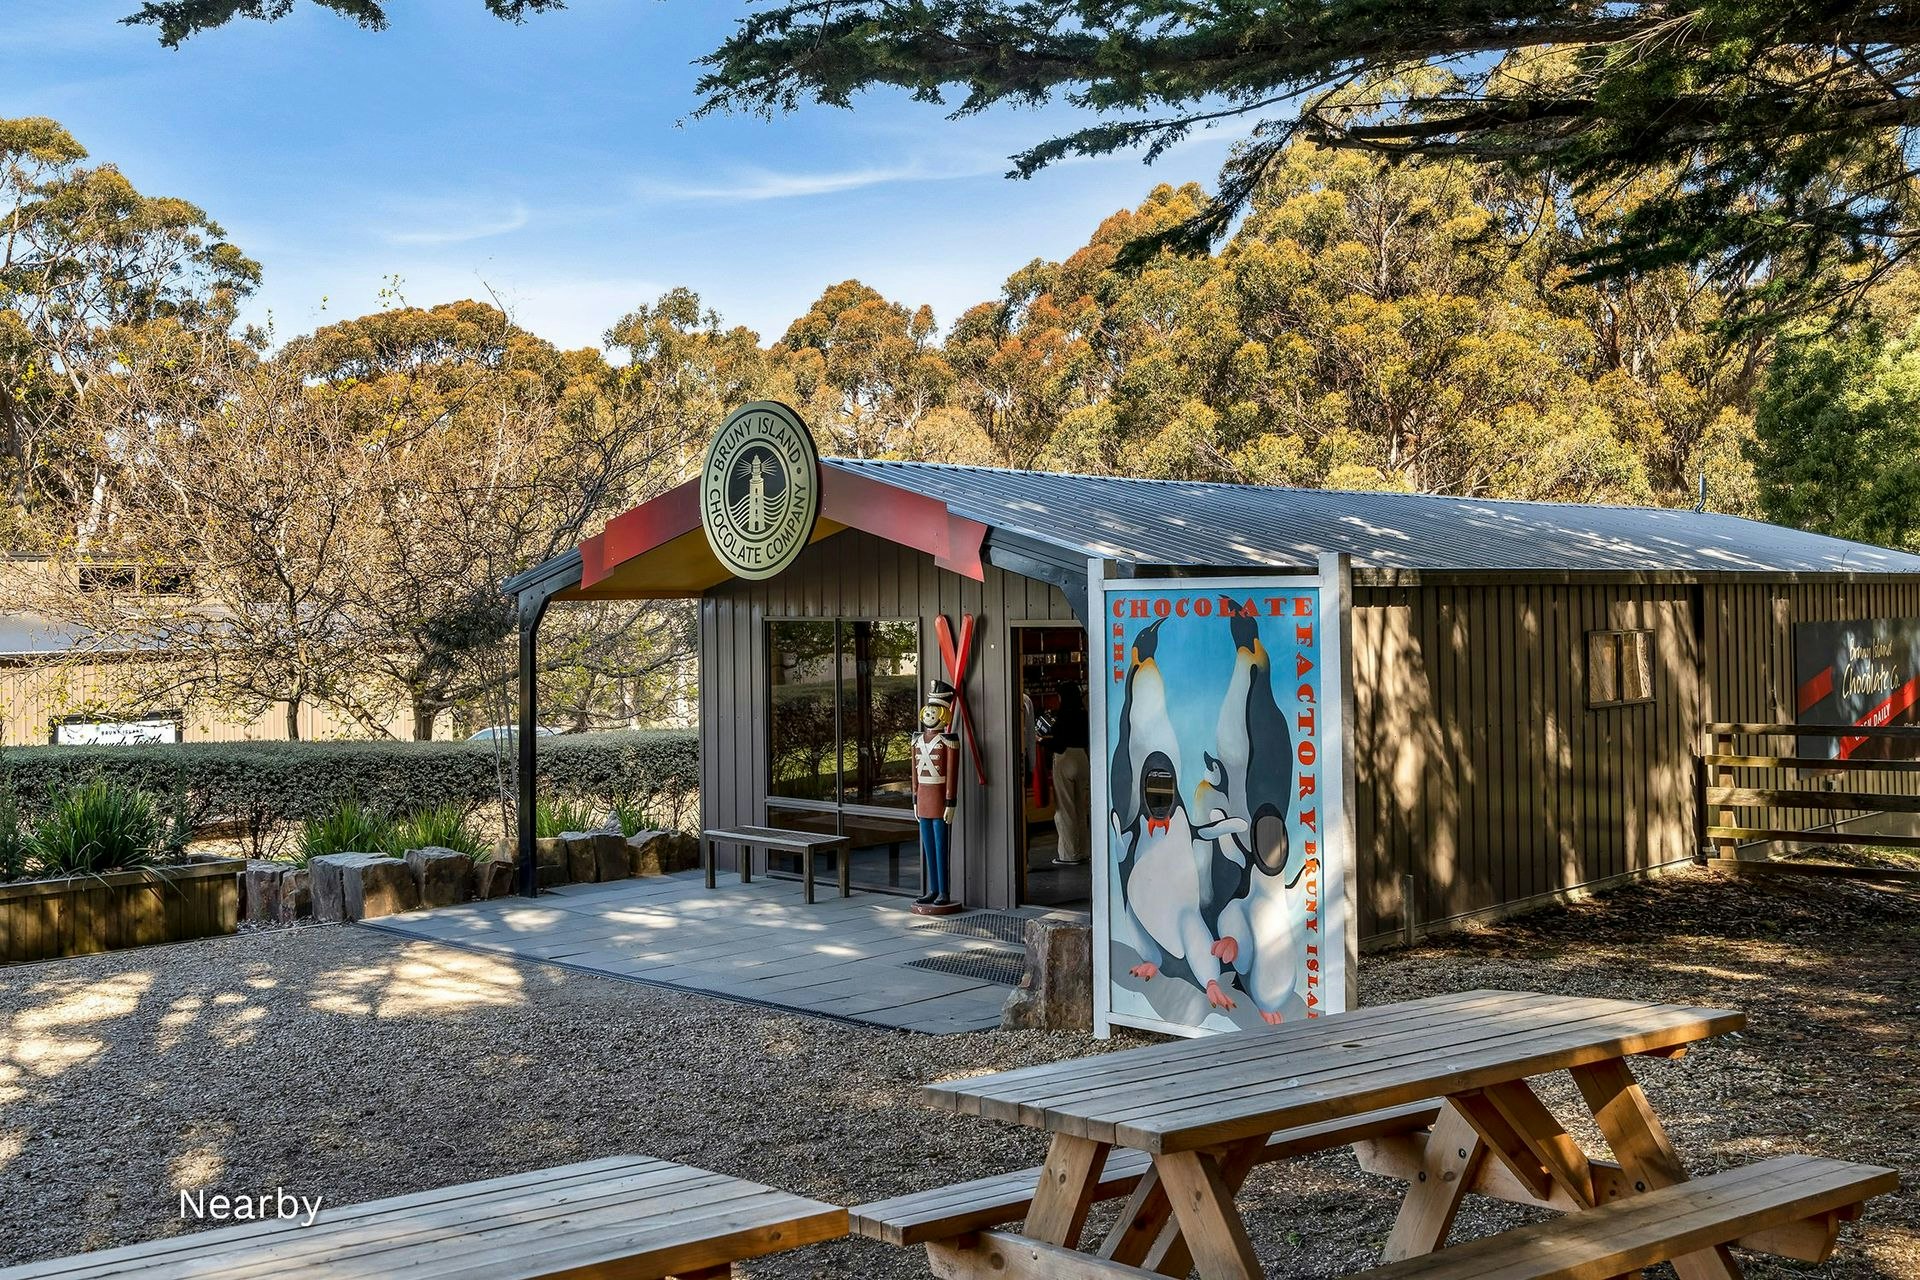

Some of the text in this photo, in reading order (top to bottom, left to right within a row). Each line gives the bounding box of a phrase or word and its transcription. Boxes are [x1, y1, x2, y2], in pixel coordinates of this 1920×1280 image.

[714, 416, 801, 473] BRUNY ISLAND
[709, 483, 807, 564] CHOCOLATE COMPANY
[1112, 597, 1313, 618] CHOCOLATE
[1112, 622, 1125, 684] THE
[1842, 663, 1889, 699] Chocolate
[1295, 622, 1317, 834] FACTORY
[1873, 702, 1891, 727] DAILY
[1304, 839, 1319, 934] BRUNY
